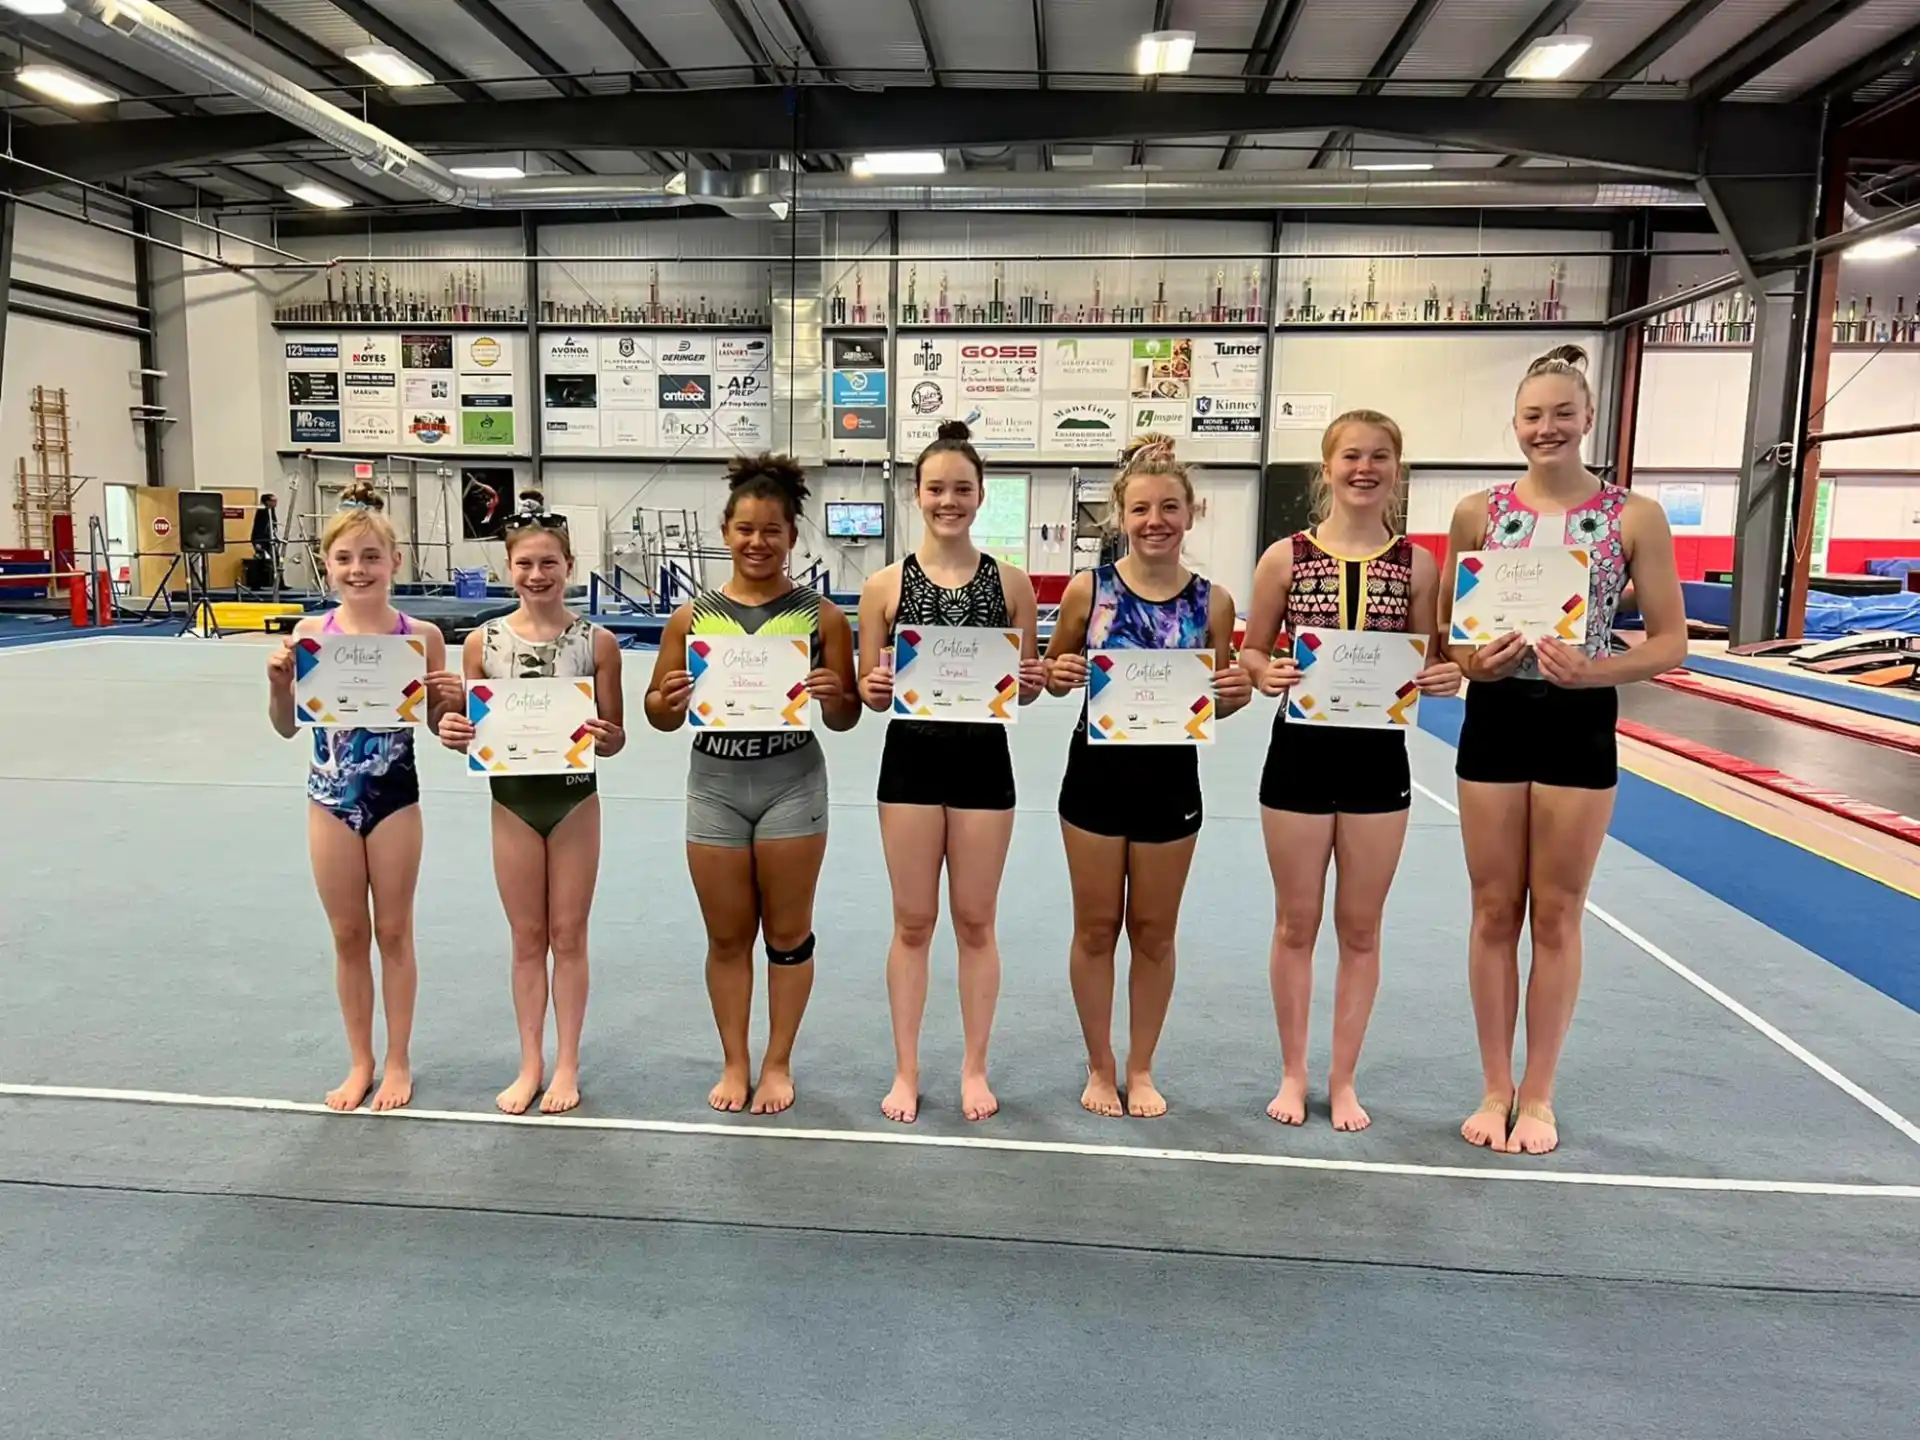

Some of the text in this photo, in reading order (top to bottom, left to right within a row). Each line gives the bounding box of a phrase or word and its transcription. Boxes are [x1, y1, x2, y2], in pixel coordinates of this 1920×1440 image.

[287, 345, 337, 356] 123 Insurance
[961, 346, 1037, 358] GOSS
[1214, 342, 1262, 355] Turner
[352, 354, 386, 362] NOYES
[728, 376, 755, 388] AP
[729, 389, 754, 397] PREP
[1053, 403, 1117, 420] Mansfield
[1215, 400, 1259, 410] Kinney
[1154, 413, 1183, 422] Inspire
[680, 423, 709, 435] KD
[1495, 558, 1544, 584] Certificate
[334, 643, 385, 666] Certificate
[932, 637, 980, 660] Certificate
[1332, 643, 1383, 666] Certificate
[722, 646, 769, 669] Certificate
[1125, 659, 1172, 682] Certificate
[505, 687, 552, 713] Certificate
[706, 735, 762, 757] NIKE
[566, 774, 590, 786] DNA
